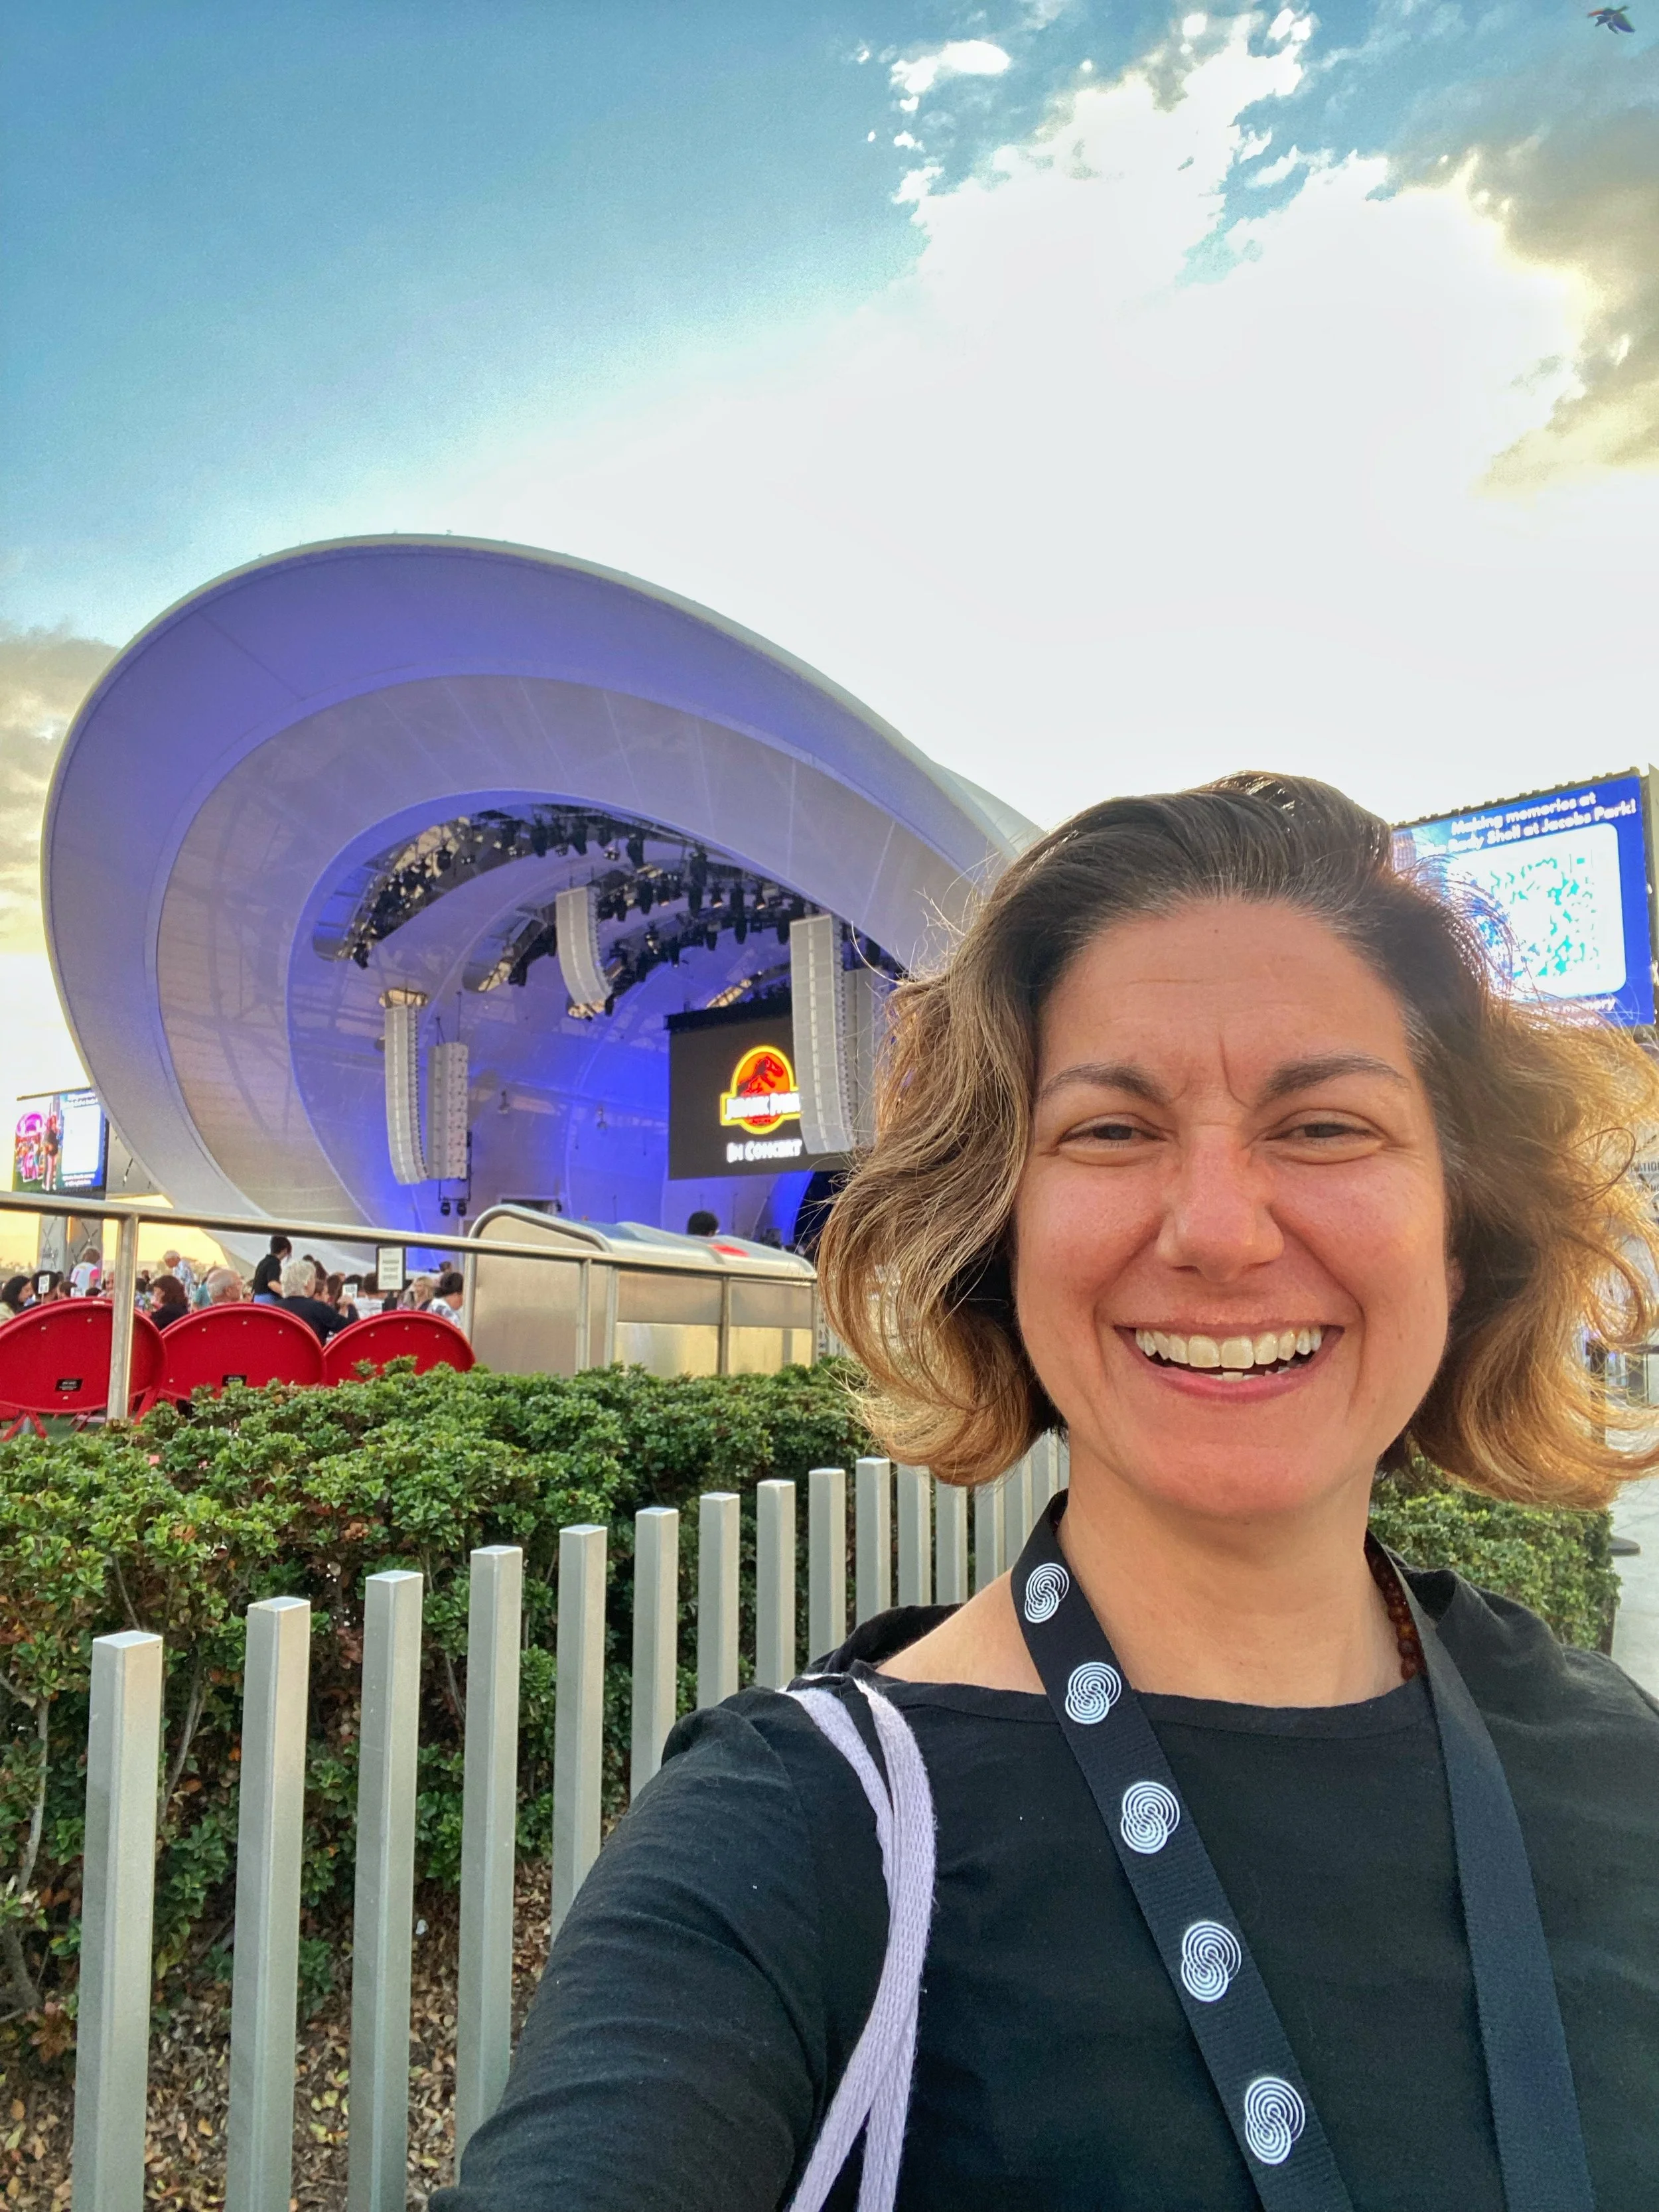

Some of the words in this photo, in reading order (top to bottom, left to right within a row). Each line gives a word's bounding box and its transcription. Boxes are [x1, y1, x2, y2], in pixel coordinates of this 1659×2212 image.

[1447, 831, 1485, 853] Rady
[1486, 824, 1521, 845] Shell
[1523, 822, 1540, 837] at
[1541, 810, 1592, 833] Jacobs
[1593, 798, 1637, 822] Park!
[1451, 814, 1504, 836] Making
[1505, 798, 1577, 824] memories
[1579, 791, 1597, 807] at
